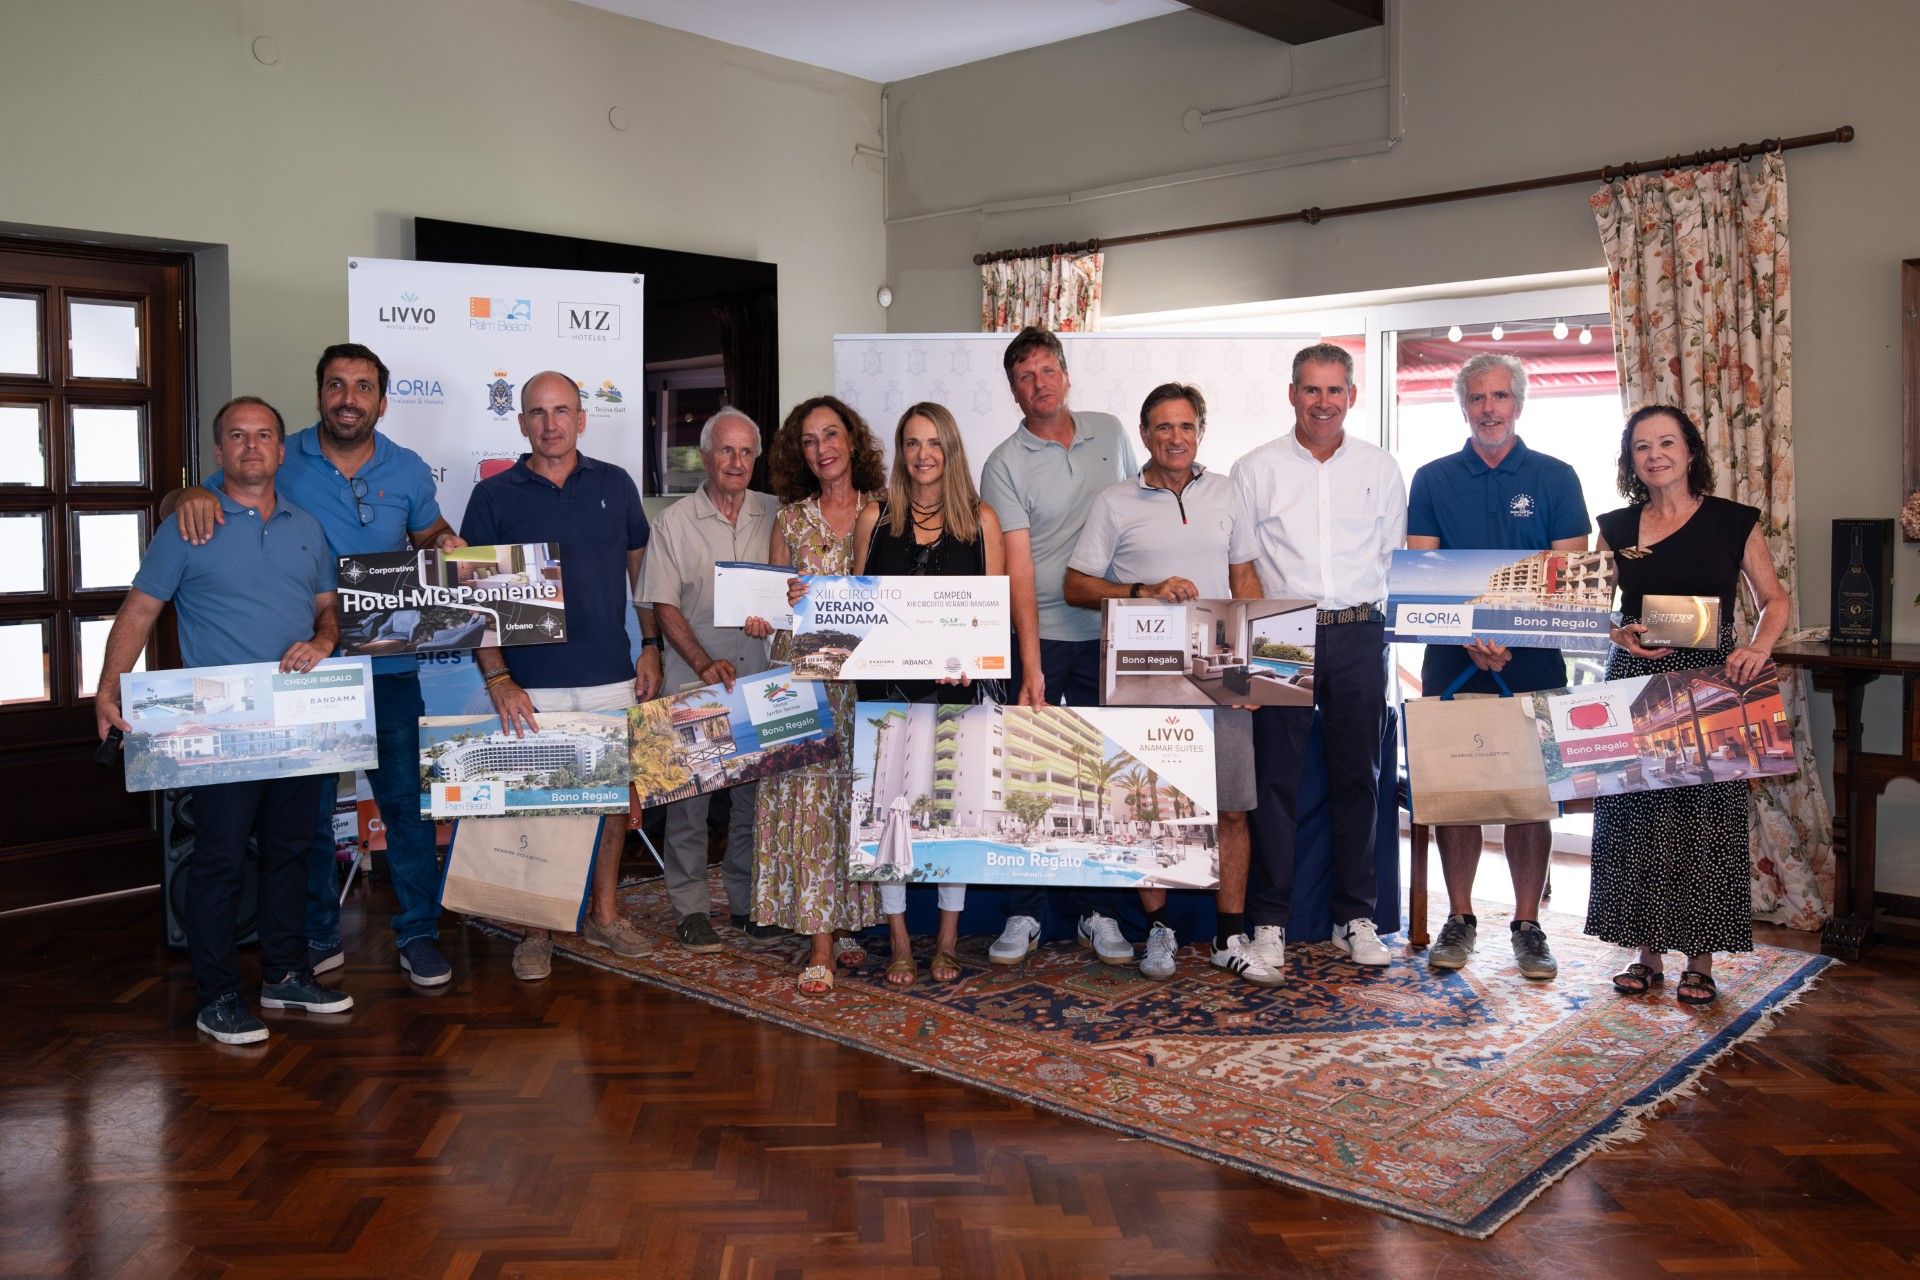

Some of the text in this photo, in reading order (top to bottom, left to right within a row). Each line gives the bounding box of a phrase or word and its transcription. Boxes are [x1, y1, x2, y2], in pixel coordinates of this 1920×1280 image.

[379, 306, 436, 324] LIVVO
[568, 309, 610, 331] MZ
[469, 318, 532, 333] Palm Beach
[571, 334, 607, 342] HOTELES
[386, 379, 444, 397] LORIA
[368, 565, 415, 575] Corporativo
[343, 582, 558, 613] Hotel MG Poniente
[815, 588, 902, 600] XIII CIRCUITO
[933, 590, 973, 600] CAMPEÓN
[815, 601, 875, 612] VERANO
[917, 600, 944, 608] CIRCUITO
[944, 600, 969, 608] VERANO
[970, 600, 1000, 608] BANDAMA
[814, 613, 889, 625] BANDAMA
[1406, 612, 1461, 625] GLORIA
[1514, 616, 1598, 630] Bono Regalo
[505, 623, 534, 631] Urbano
[1136, 619, 1165, 633] MZ
[1122, 656, 1178, 666] Bono Regalo
[284, 674, 352, 686] CHEQUE REGALO
[310, 694, 357, 704] BANDAMA
[772, 701, 788, 709] Hotel
[761, 717, 815, 737] Bono Regalo
[1147, 727, 1194, 742] LIVVO
[1139, 744, 1204, 753] ANAMAR SUITES
[1566, 741, 1629, 756] Bono Regalo
[551, 790, 619, 803] Bono Regalo
[465, 801, 492, 811] Beach
[986, 852, 1082, 870] Bono Regalo
